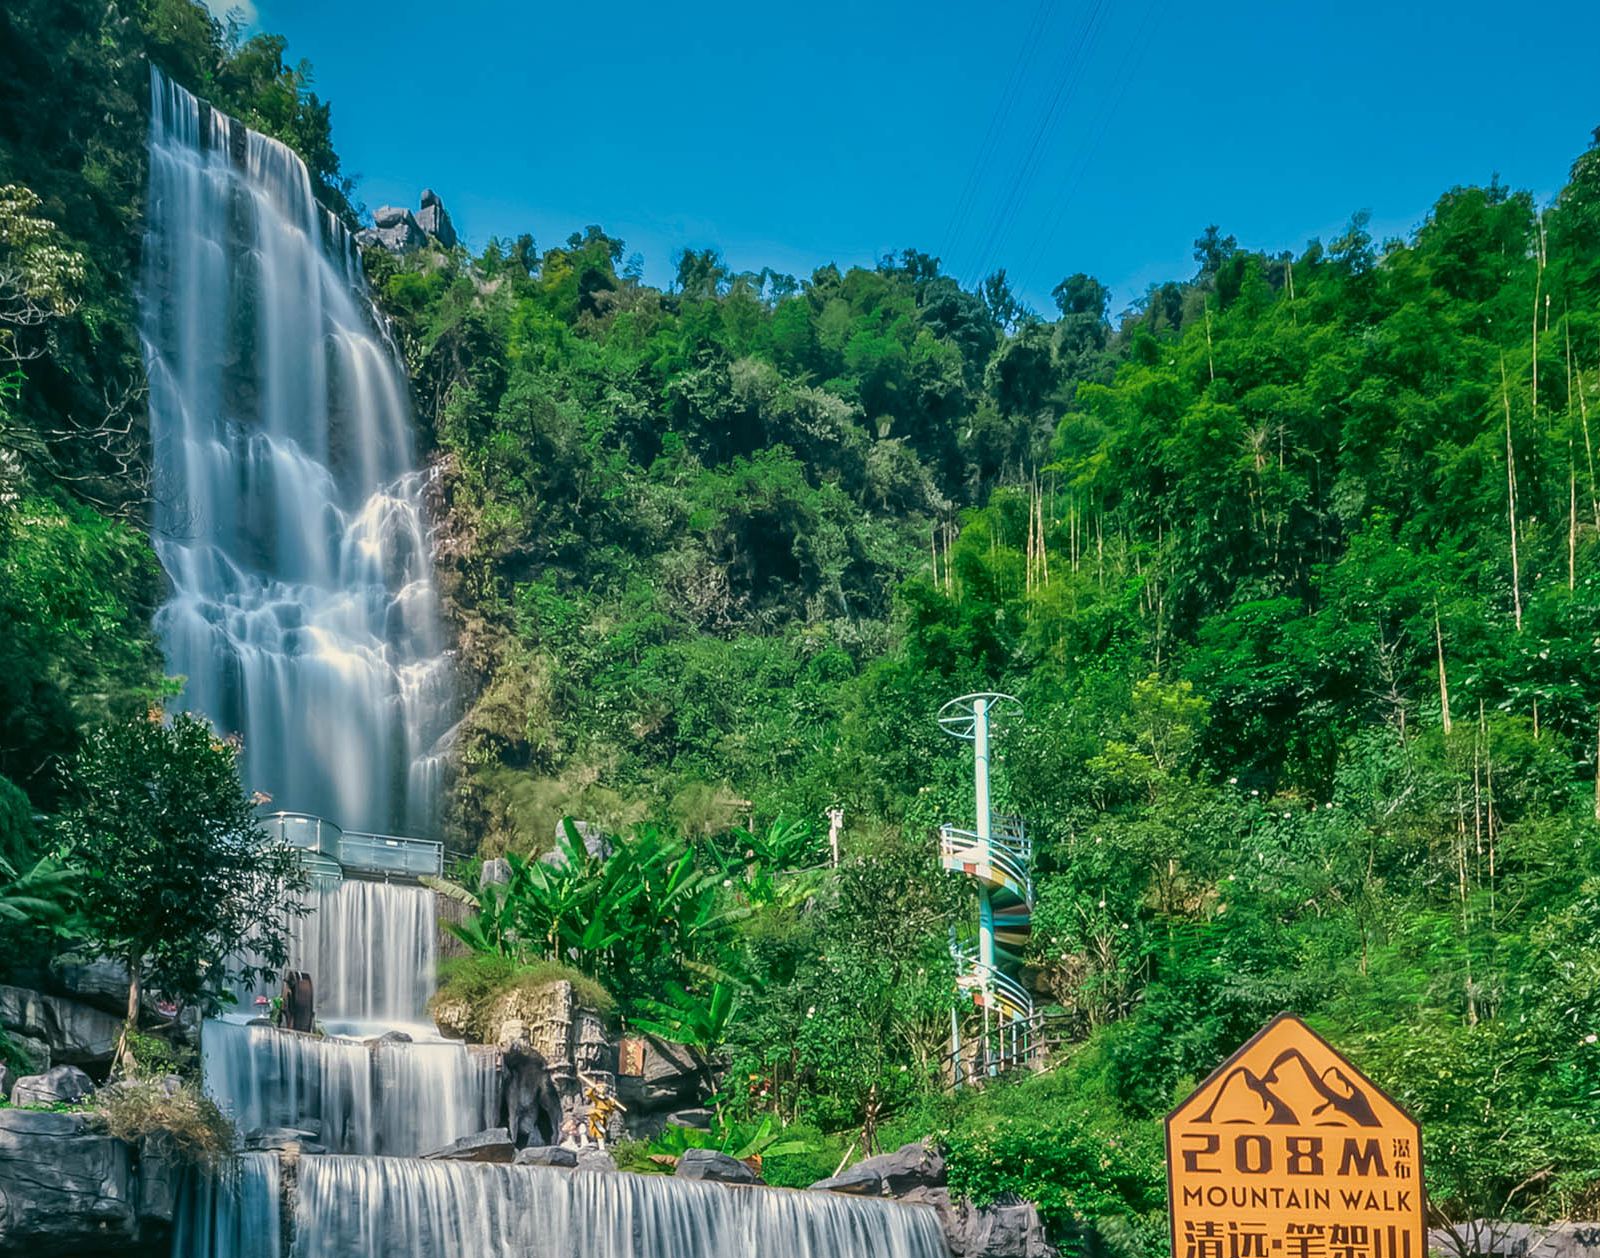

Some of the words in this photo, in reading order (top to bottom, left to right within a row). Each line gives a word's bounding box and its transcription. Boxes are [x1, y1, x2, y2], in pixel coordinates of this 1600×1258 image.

[1181, 1134, 1389, 1177] 208M
[1183, 1185, 1330, 1210] MOUNTAIN
[1339, 1189, 1412, 1212] WALK
